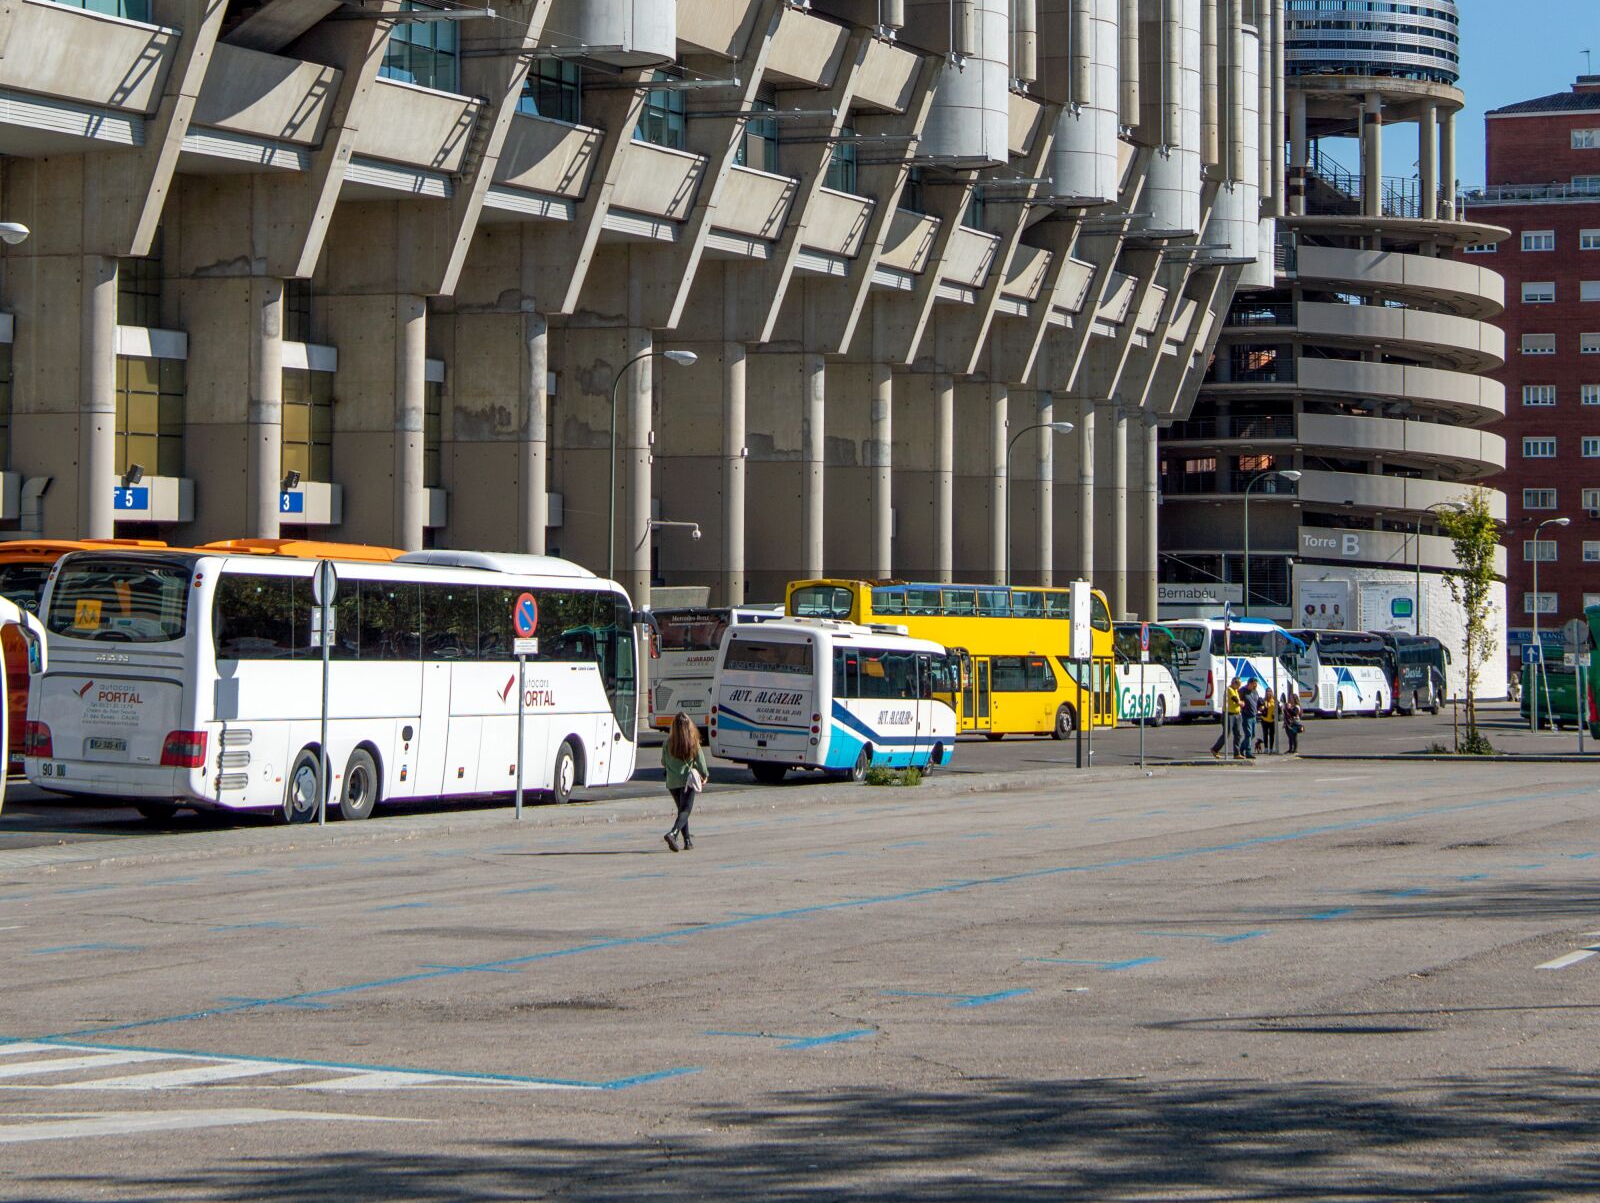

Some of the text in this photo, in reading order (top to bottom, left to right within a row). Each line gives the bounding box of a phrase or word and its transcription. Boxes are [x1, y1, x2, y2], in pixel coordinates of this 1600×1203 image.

[125, 489, 133, 507] 5
[283, 494, 290, 511] 3
[1302, 533, 1361, 556] Torre B
[1158, 585, 1216, 600] Bernabéu
[99, 684, 135, 692] autocars
[524, 678, 549, 688] utocars
[98, 691, 144, 704] PORTAL
[524, 690, 555, 707] ORTAL
[729, 689, 803, 705] AUT. ALCAZAR
[1121, 684, 1156, 719] Casal
[42, 763, 53, 776] 90
